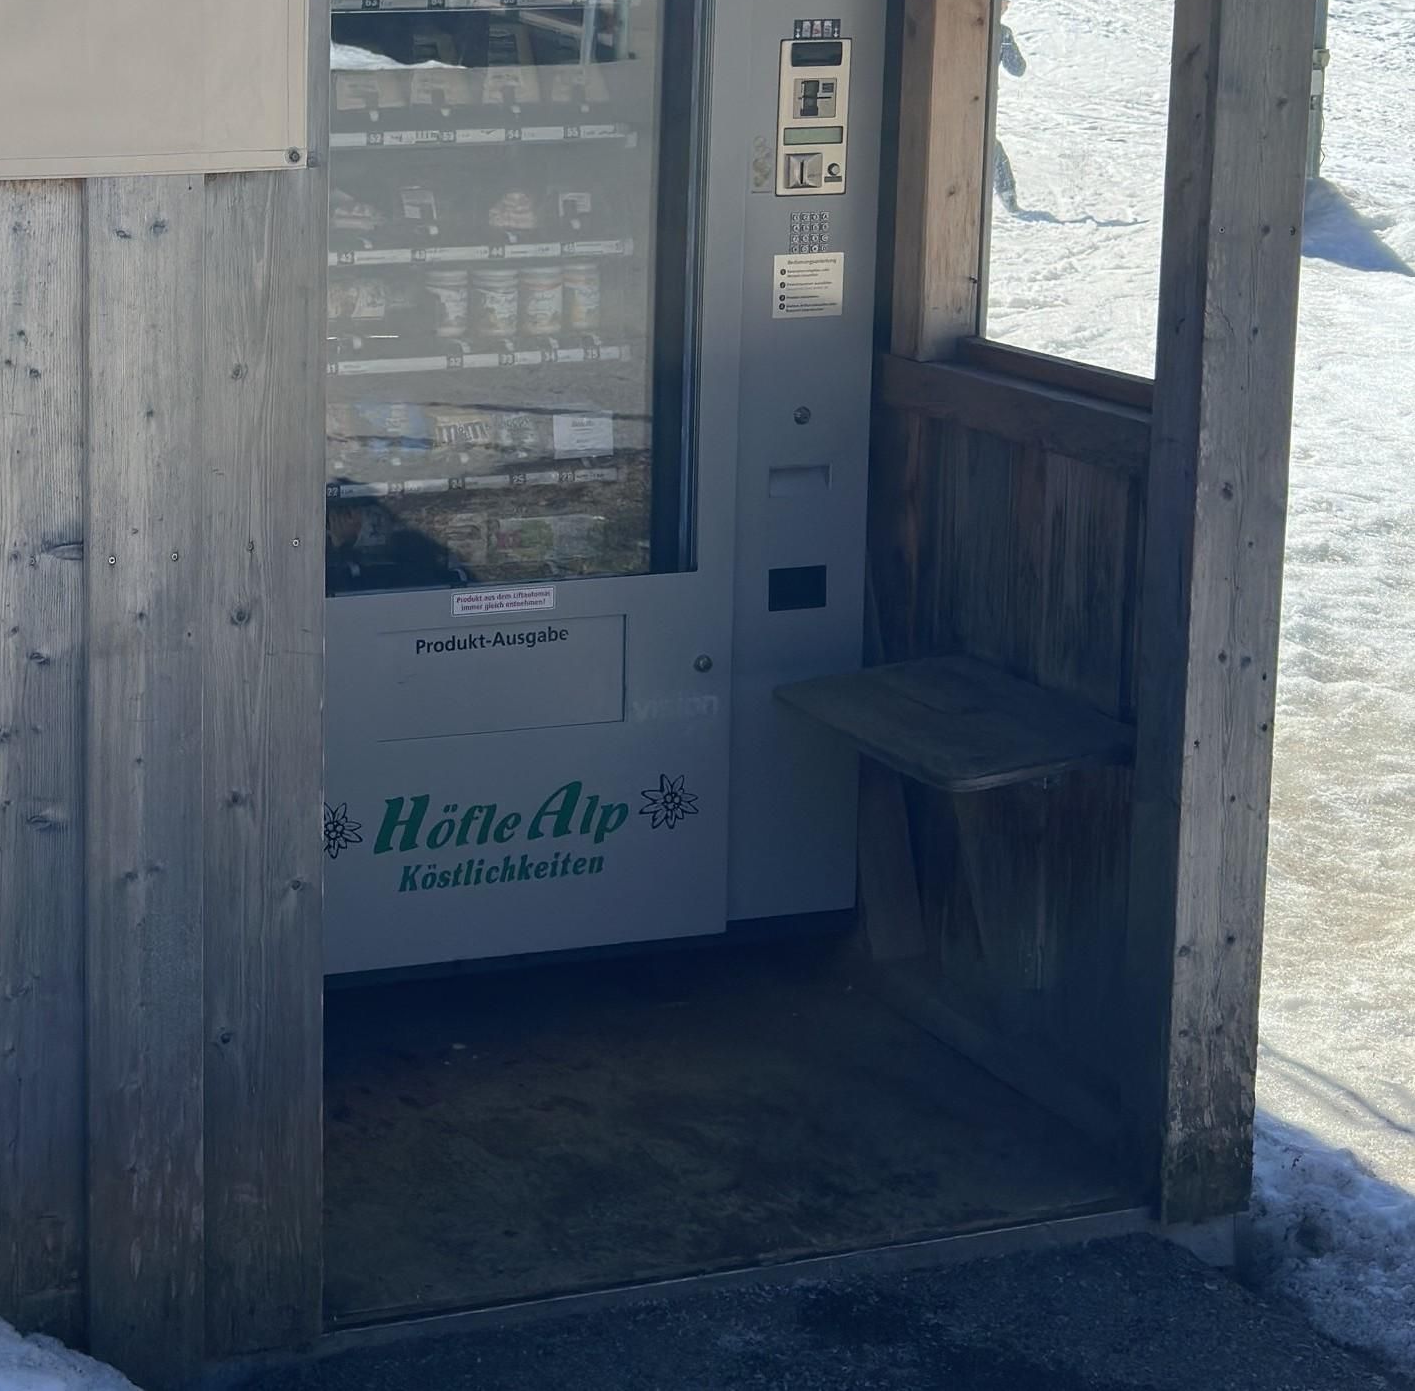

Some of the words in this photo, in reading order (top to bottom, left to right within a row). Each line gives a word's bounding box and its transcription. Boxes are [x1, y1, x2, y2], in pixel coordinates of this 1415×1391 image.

[456, 594, 482, 604] Produkt
[416, 626, 569, 655] Produkt-Ausgabe
[373, 793, 523, 855] Höfle
[527, 780, 630, 845] Alp
[397, 851, 605, 893] Köstlichkeiten
